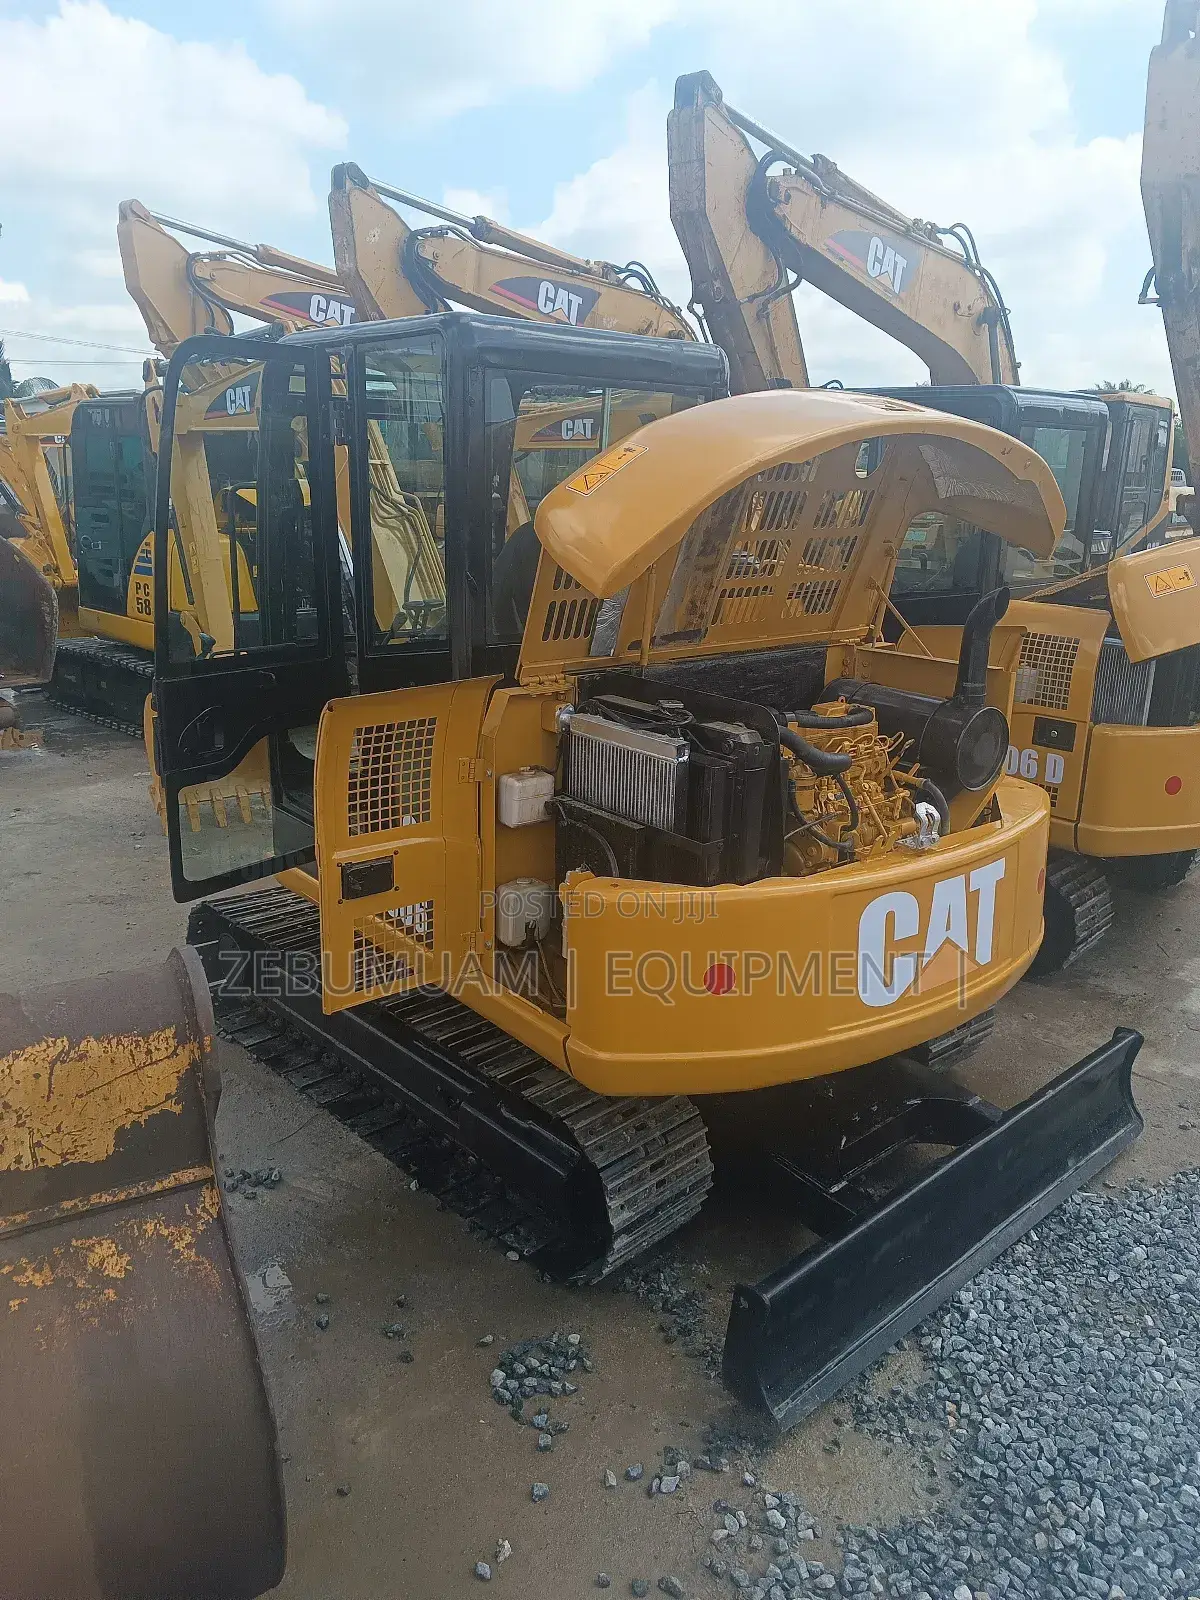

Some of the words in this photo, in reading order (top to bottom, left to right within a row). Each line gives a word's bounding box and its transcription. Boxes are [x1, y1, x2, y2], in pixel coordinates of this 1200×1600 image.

[866, 236, 908, 294] CAT
[309, 294, 356, 326] CAT
[537, 280, 583, 326] CAT
[226, 385, 251, 415] CAT
[561, 418, 594, 440] CAT
[136, 597, 152, 616] 58
[1045, 752, 1065, 784] D
[857, 857, 1006, 1008] CAT
